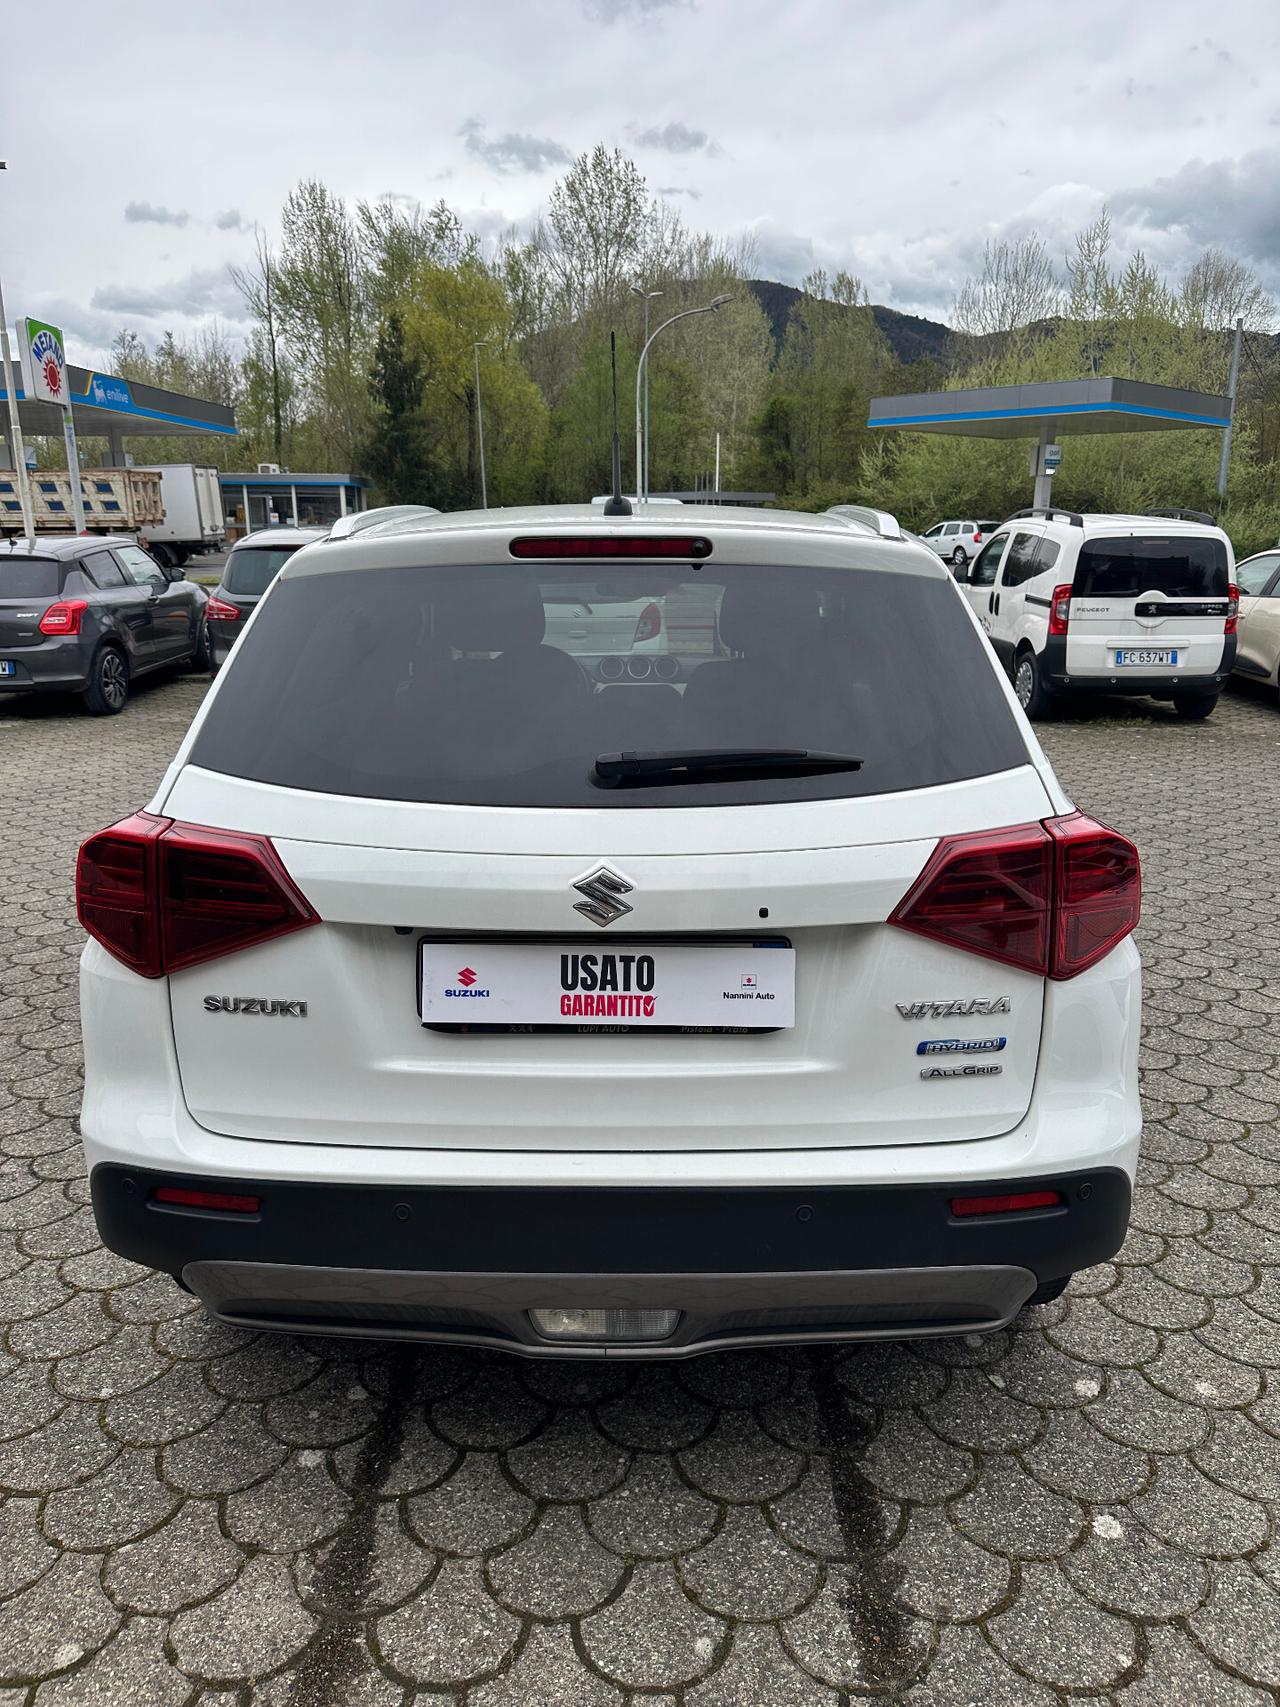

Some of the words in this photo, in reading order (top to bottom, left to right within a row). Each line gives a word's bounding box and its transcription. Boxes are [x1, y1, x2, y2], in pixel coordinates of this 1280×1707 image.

[32, 331, 64, 369] METANO
[1123, 652, 1136, 663] FC
[1139, 652, 1170, 663] 637WT
[560, 954, 655, 992] USATO
[444, 989, 490, 998] SUZUKI
[723, 991, 754, 1000] Nannini
[755, 992, 775, 1000] Auto
[203, 995, 308, 1018] SUZUKI
[560, 994, 655, 1017] GARANTITO
[895, 996, 1011, 1020] VITARA
[577, 1024, 599, 1033] LUPI
[601, 1024, 629, 1033] AUTO
[931, 1039, 996, 1053] HYBRID
